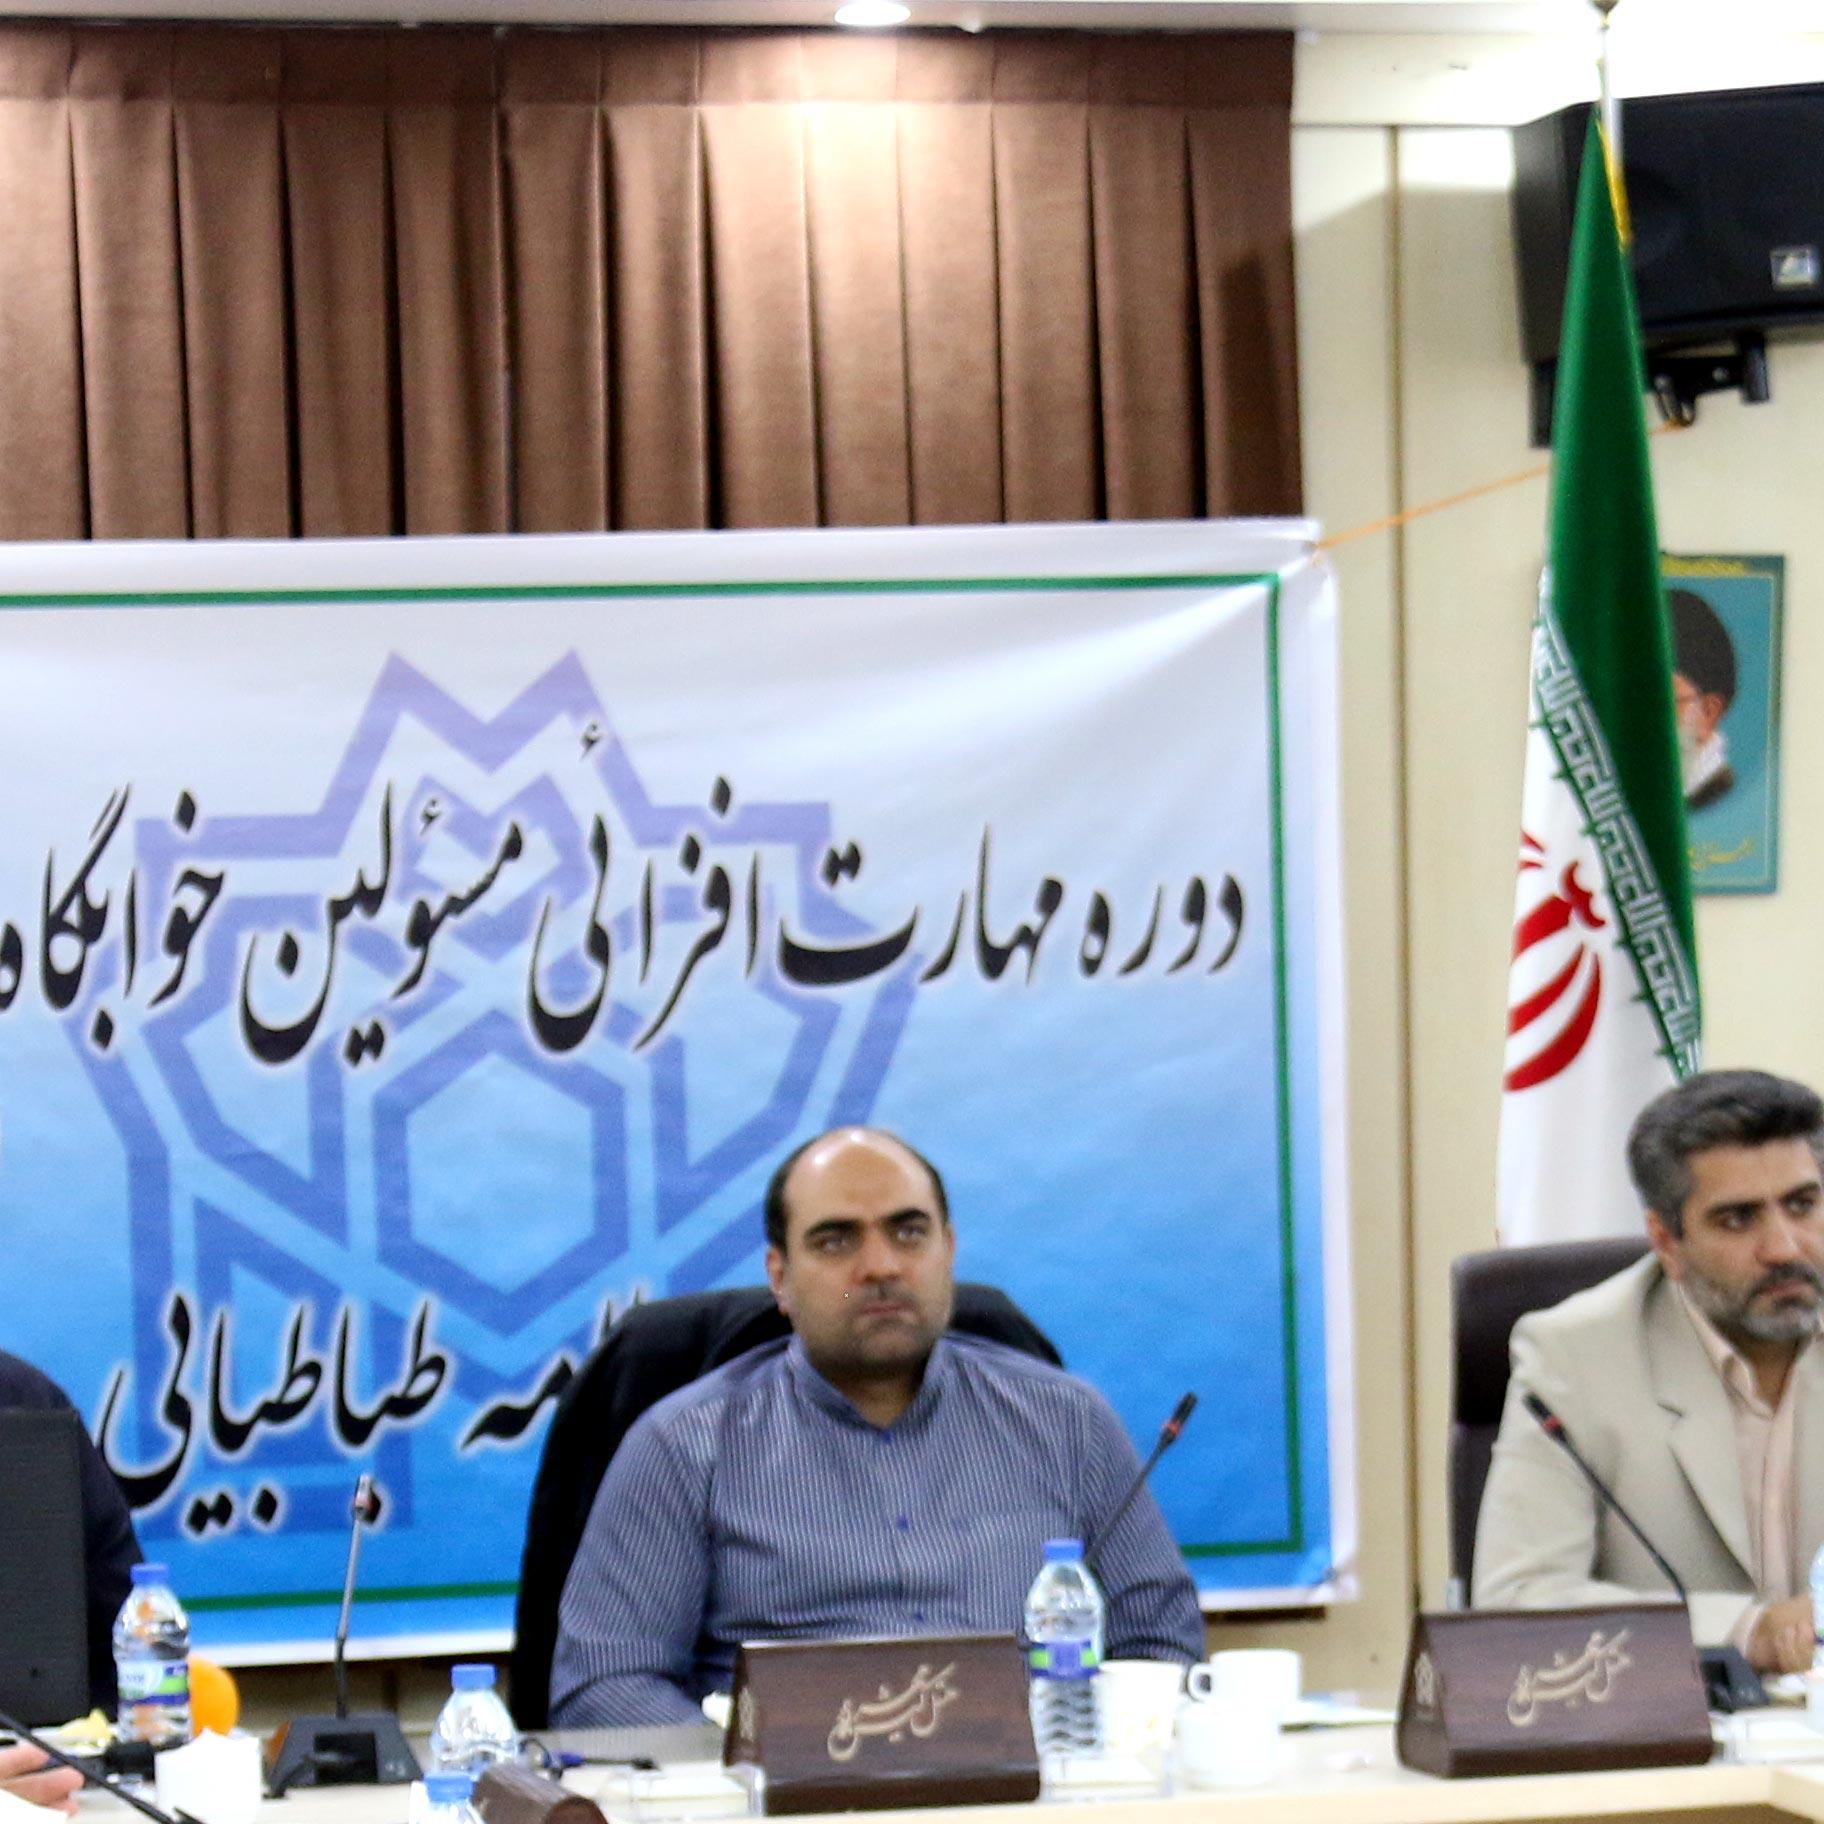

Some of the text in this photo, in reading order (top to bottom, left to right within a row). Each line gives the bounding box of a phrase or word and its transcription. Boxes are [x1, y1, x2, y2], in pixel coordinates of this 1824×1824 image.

[240, 778, 524, 1067] مسئولین
[778, 822, 1063, 987] مهارت
[1077, 872, 1243, 978] دوره
